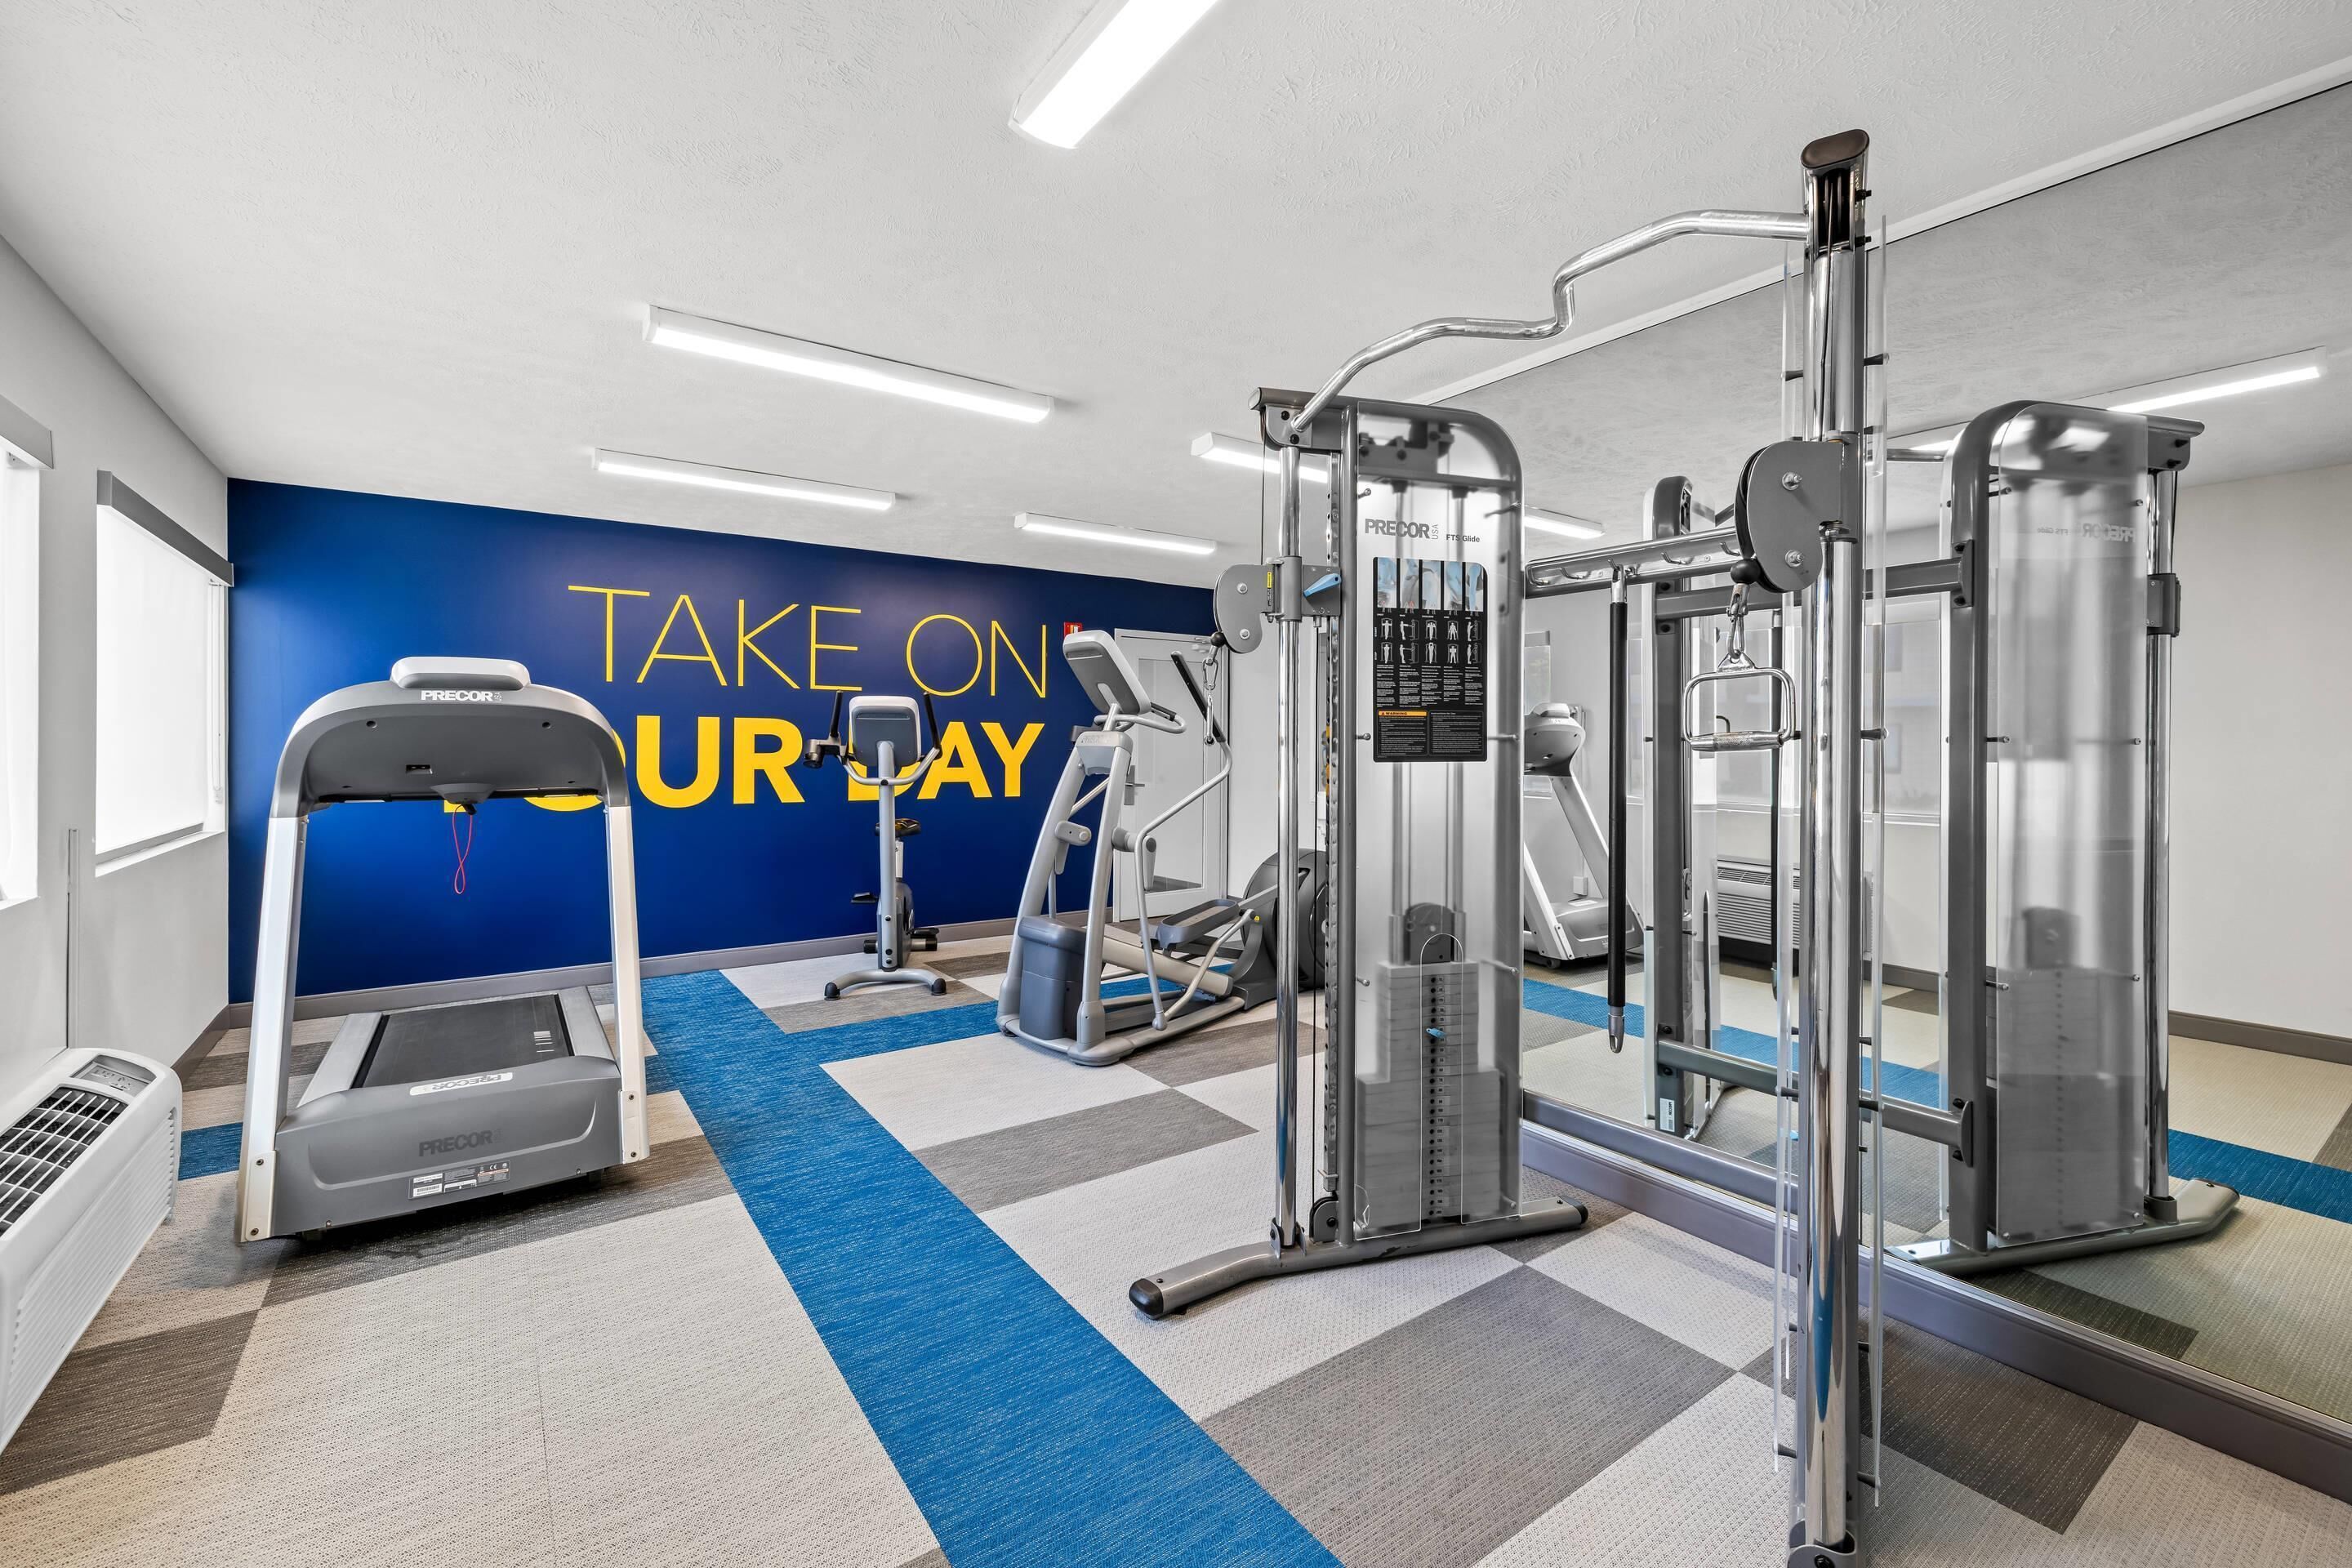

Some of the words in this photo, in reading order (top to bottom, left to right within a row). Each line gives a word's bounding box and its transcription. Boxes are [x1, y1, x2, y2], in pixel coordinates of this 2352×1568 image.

[1365, 518, 1430, 539] PRECOR
[1431, 523, 1439, 540] USA
[1446, 533, 1461, 541] FTS
[1462, 535, 1481, 543] Glide
[568, 585, 861, 692] TAKE
[906, 614, 1046, 697] ON
[421, 690, 493, 702] PRECOR
[432, 1074, 501, 1090] PRECOR
[419, 1130, 493, 1157] PRECOR
